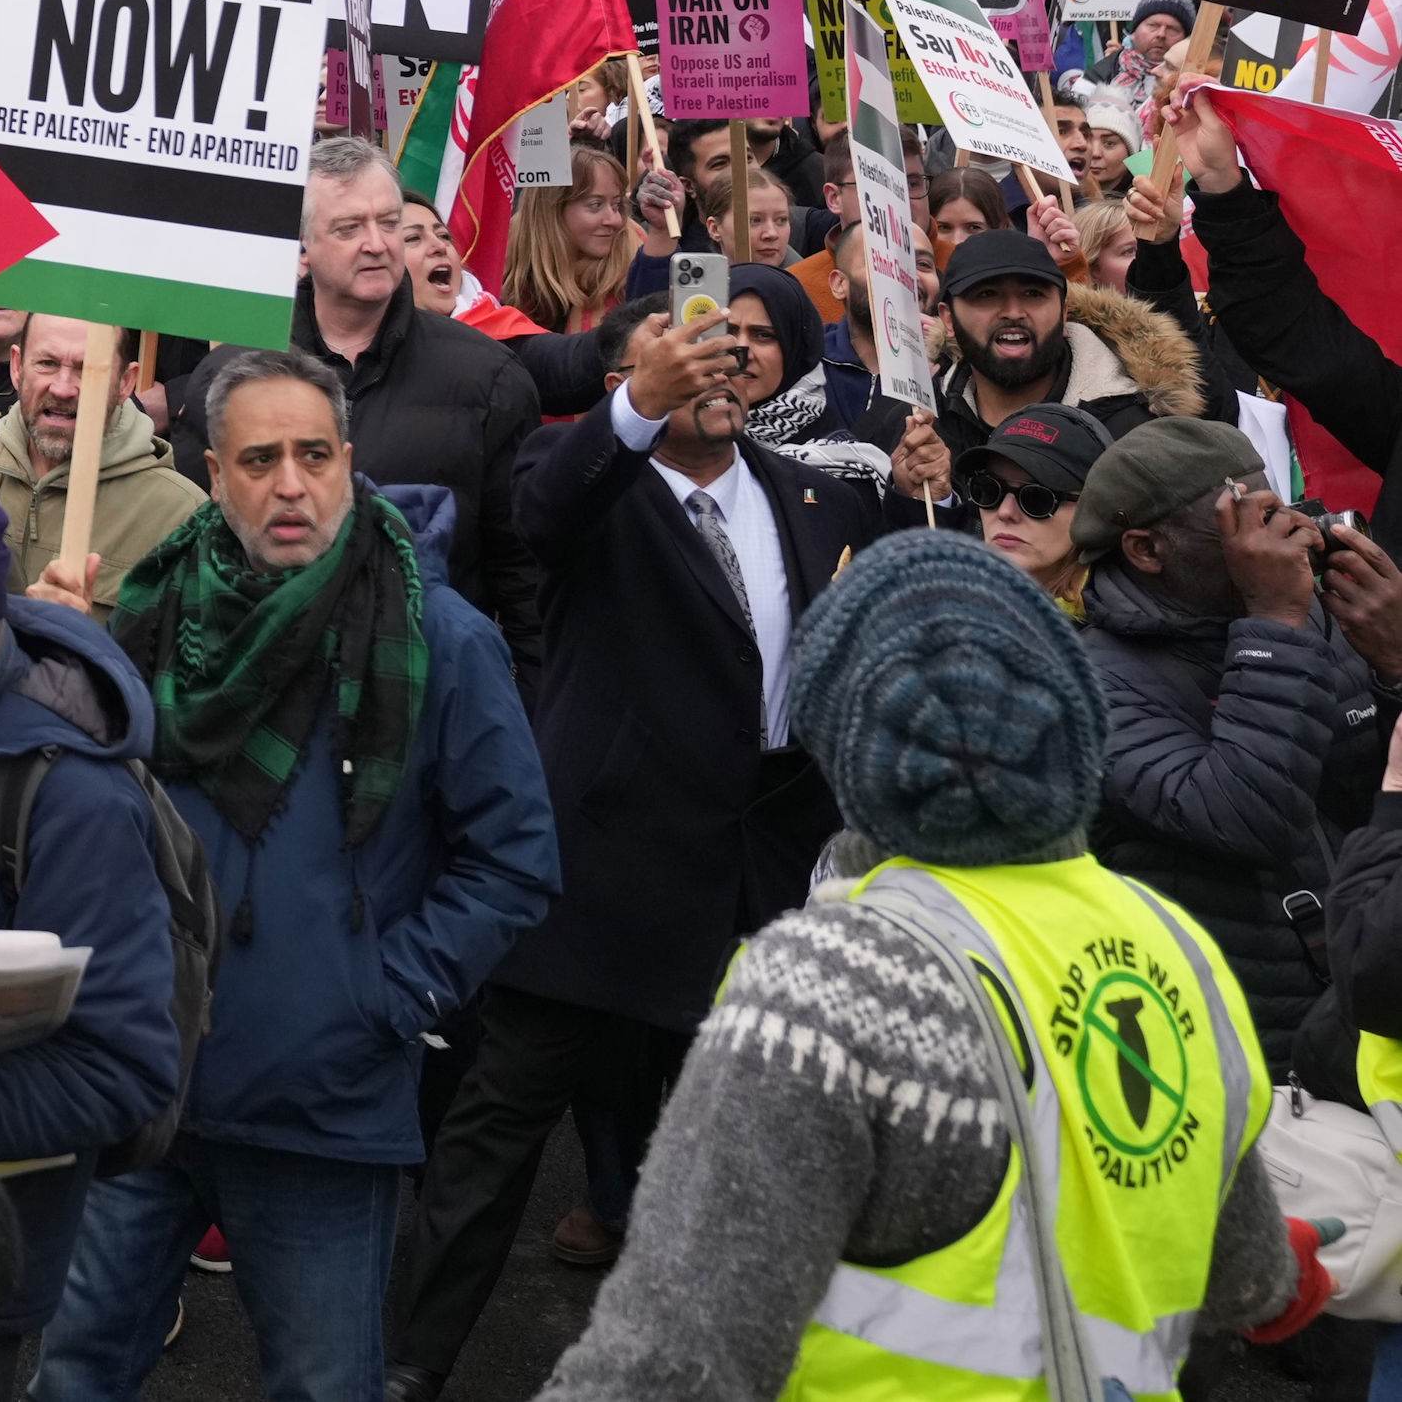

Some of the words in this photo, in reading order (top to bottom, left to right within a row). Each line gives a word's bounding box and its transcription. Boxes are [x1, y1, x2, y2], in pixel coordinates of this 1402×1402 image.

[670, 15, 730, 45] IRAN
[896, 0, 965, 32] Palestinians
[671, 54, 719, 72] Oppose
[724, 55, 742, 69] US
[746, 54, 771, 69] and
[909, 24, 958, 63] Say
[955, 37, 989, 69] No
[992, 55, 1014, 79] to
[671, 73, 714, 89] Israeli
[717, 72, 797, 89] imperialism
[922, 59, 970, 83] Ethnic
[972, 70, 1032, 109] Cleansing
[1234, 59, 1276, 92] NO
[674, 95, 705, 111] Free
[709, 94, 769, 111] Palestine
[33, 111, 129, 148] PALESTINE
[147, 126, 185, 158] END
[191, 142, 299, 172] APARTHEID
[969, 139, 1063, 177] www.PFBUK.com
[865, 192, 889, 248] Say
[1051, 963, 1086, 1058] STOP
[1085, 938, 1137, 970] THE
[1146, 953, 1195, 1039] WAR
